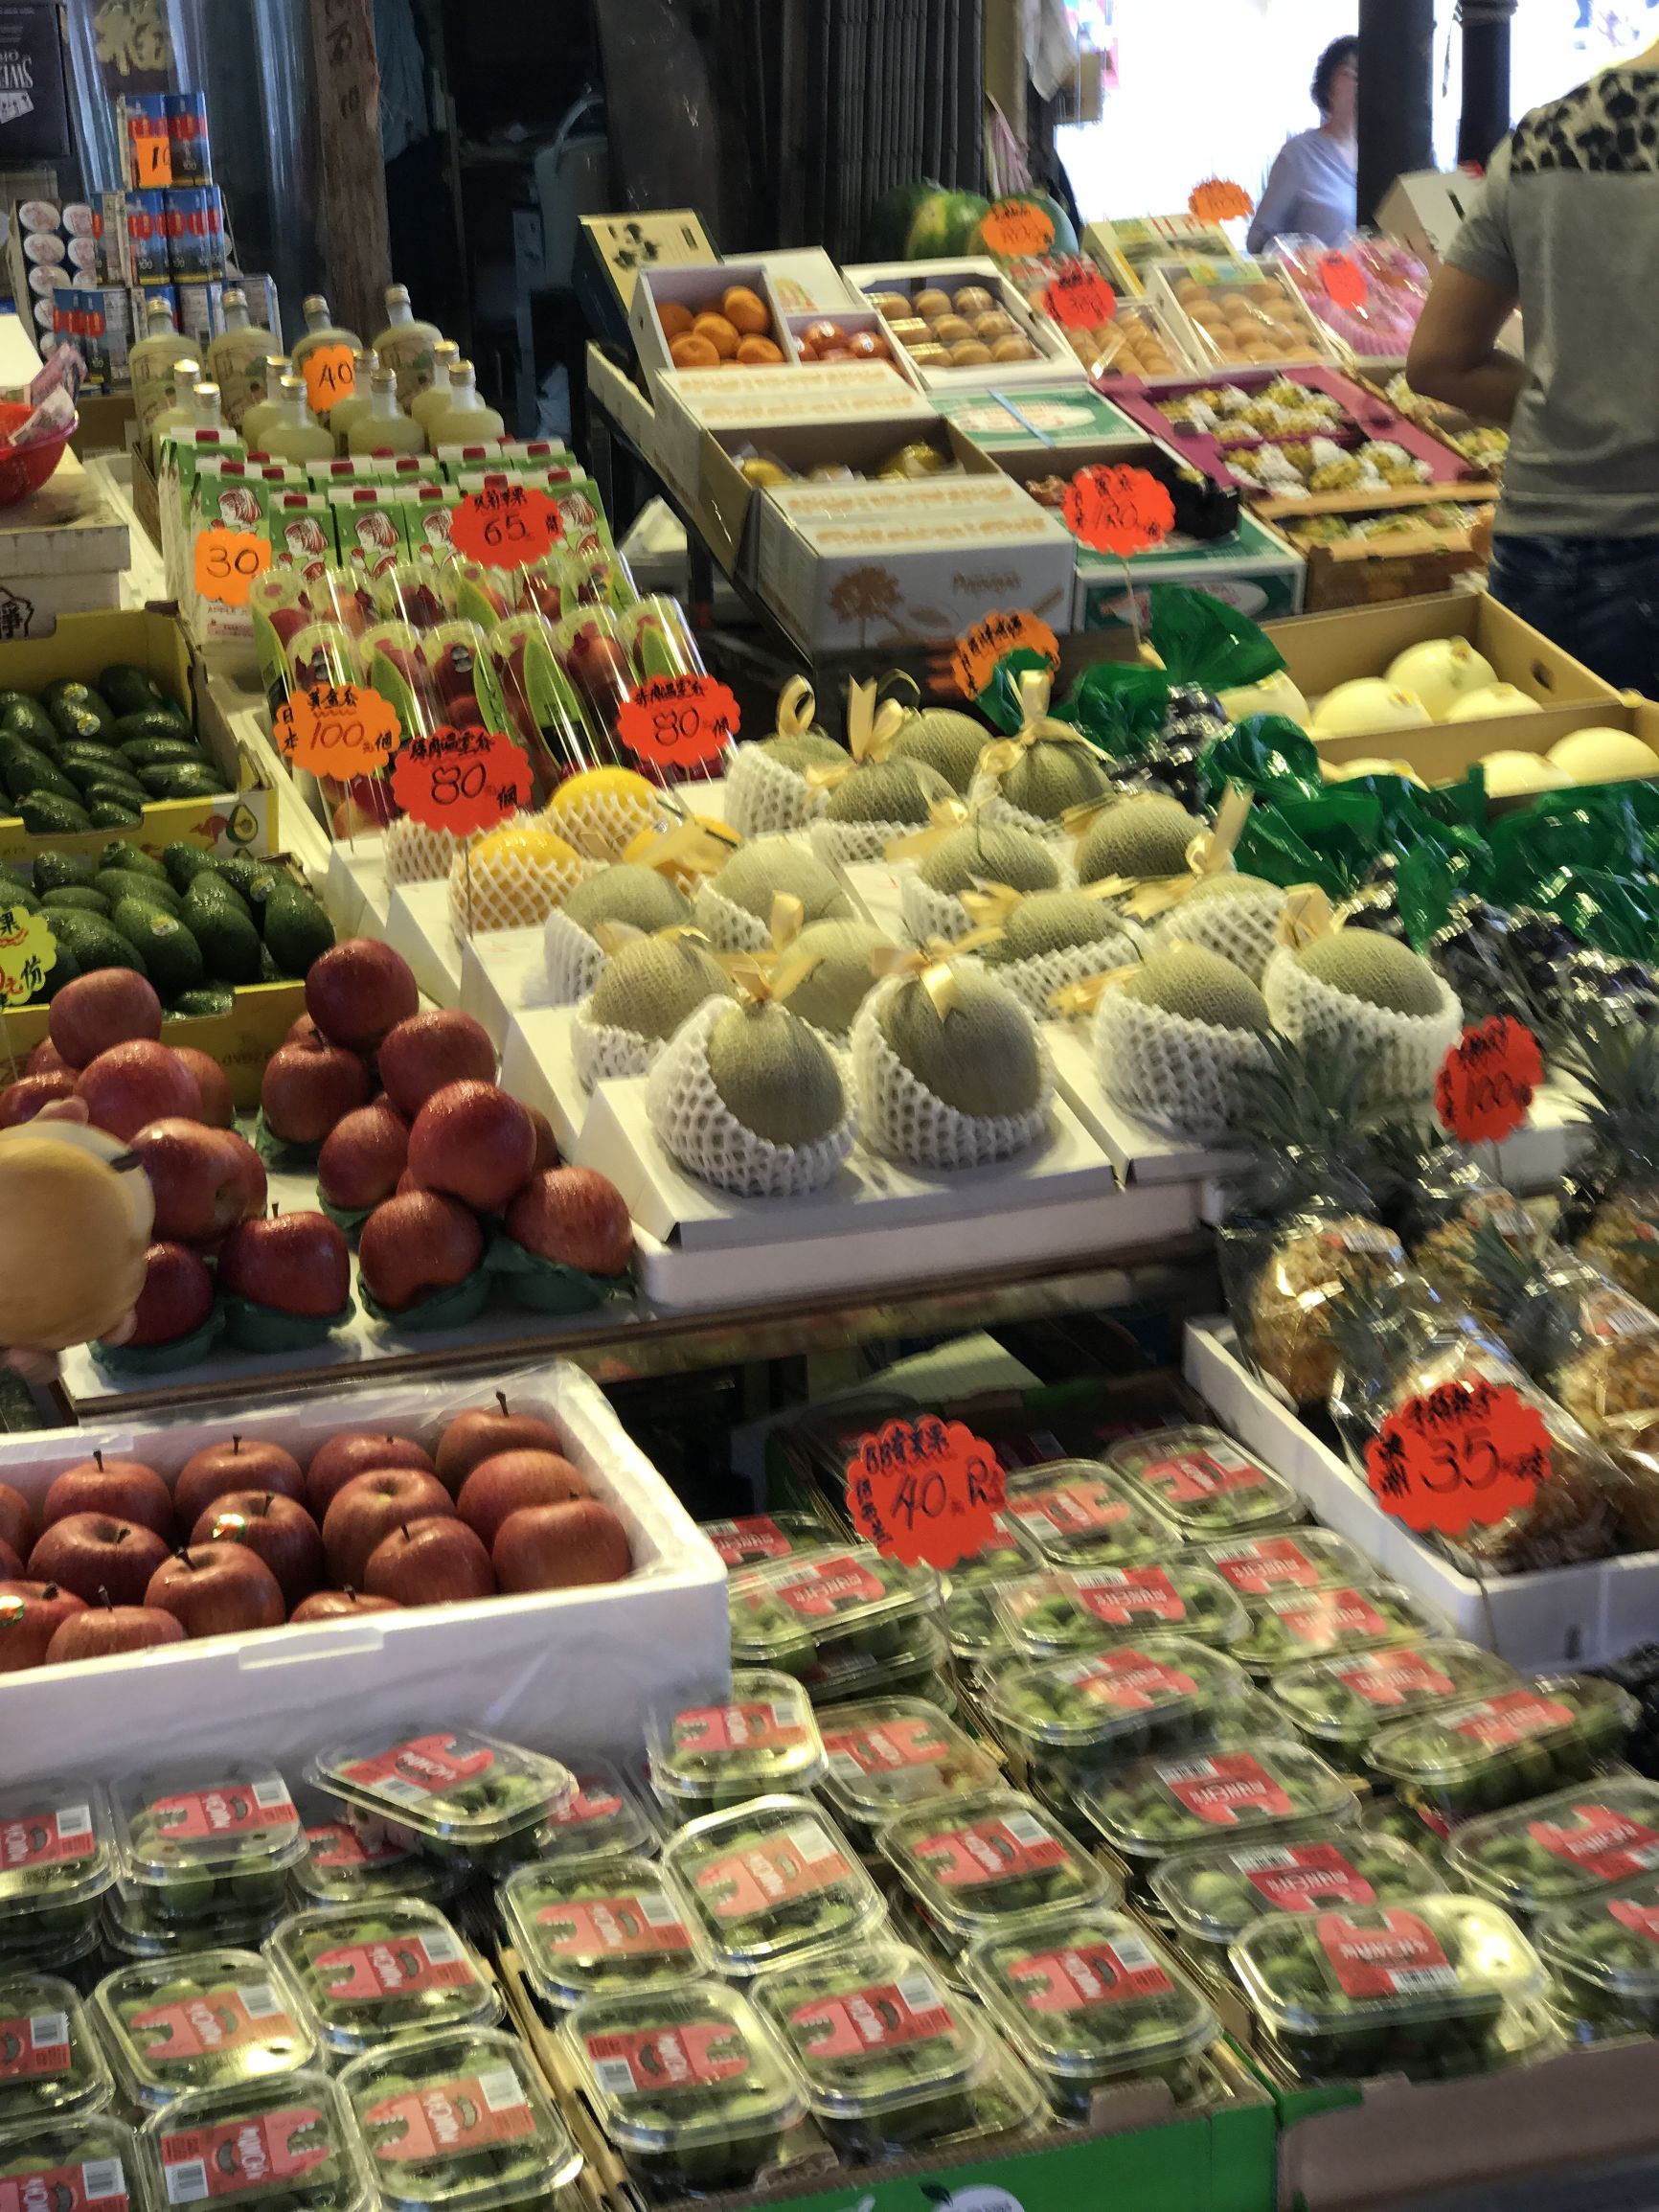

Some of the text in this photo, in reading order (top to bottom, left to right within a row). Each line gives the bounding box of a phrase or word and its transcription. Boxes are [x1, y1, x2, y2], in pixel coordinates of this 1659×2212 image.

[318, 360, 353, 391] 40
[484, 513, 527, 547] 65
[206, 545, 260, 578] 30
[309, 721, 366, 750] 100
[653, 707, 700, 747] 80
[431, 762, 487, 805] 80
[1420, 1425, 1502, 1494] 35
[891, 1470, 947, 1531] 40
